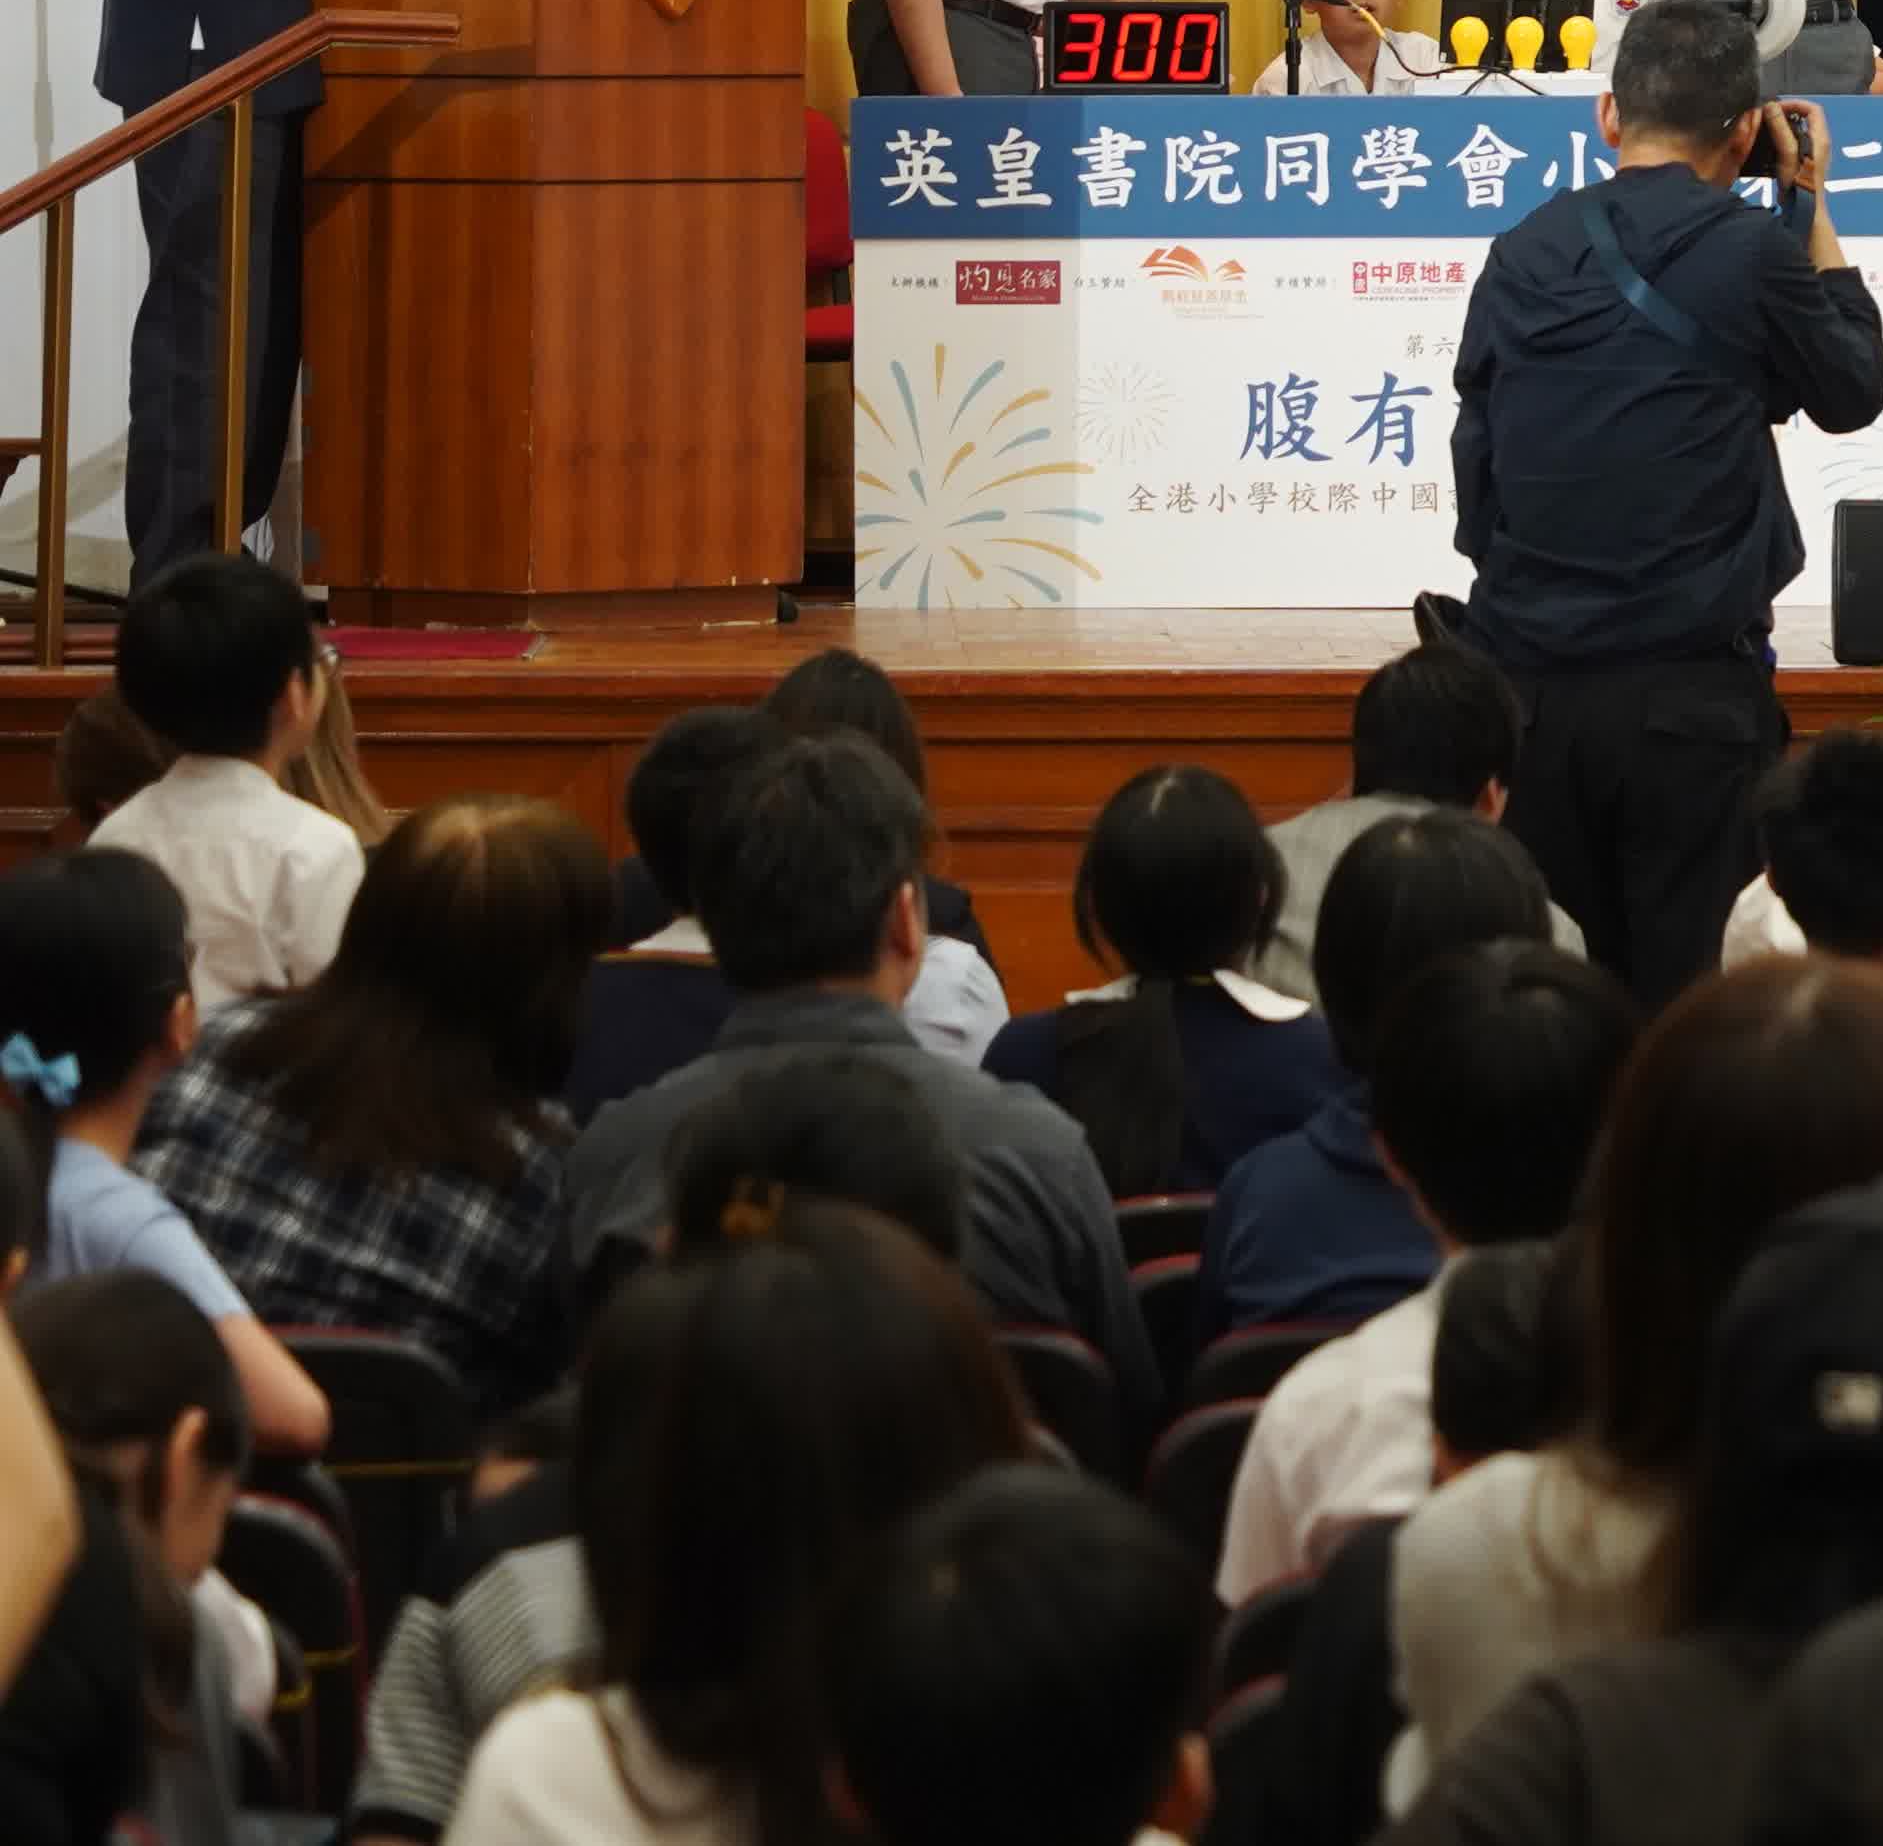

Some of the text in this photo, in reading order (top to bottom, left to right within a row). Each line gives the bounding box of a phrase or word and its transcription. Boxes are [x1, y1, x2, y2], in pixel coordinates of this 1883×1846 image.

[1059, 12, 1218, 83] 300
[958, 262, 1057, 292] 灼見名家
[1371, 261, 1467, 284] 中原地產
[1239, 372, 1460, 467] 腹有
